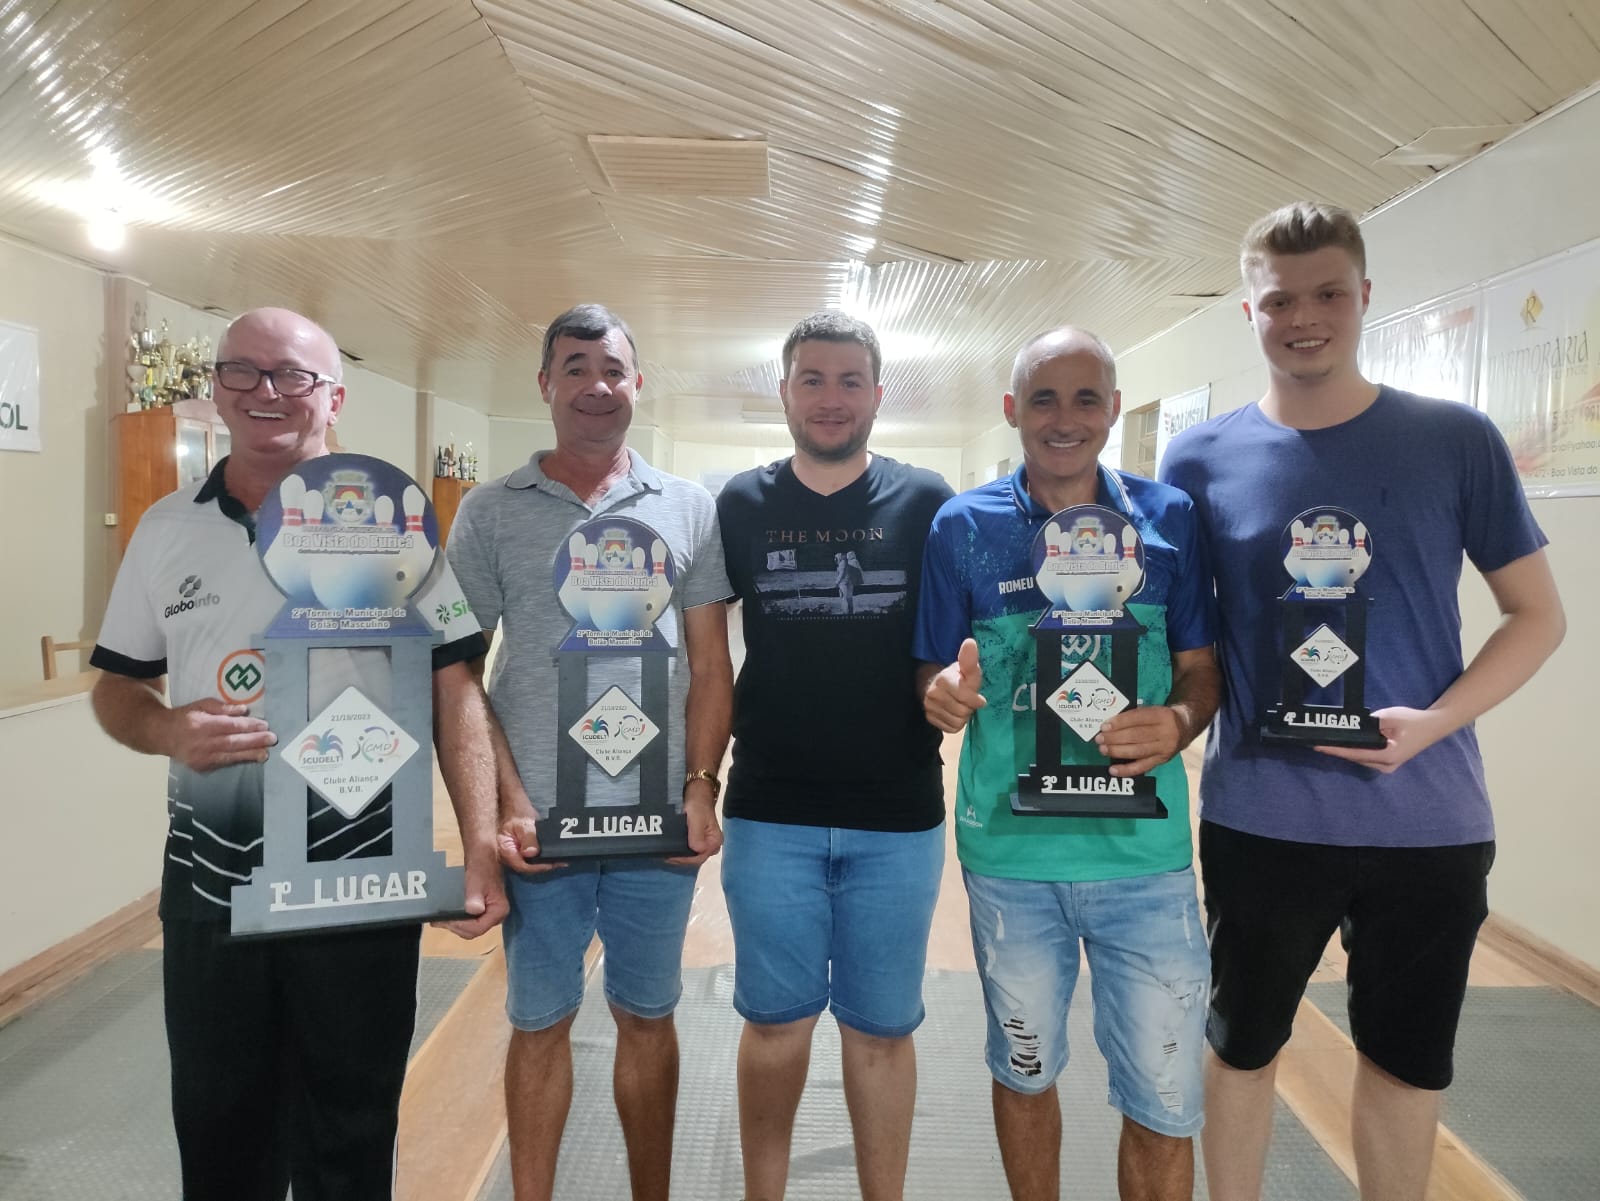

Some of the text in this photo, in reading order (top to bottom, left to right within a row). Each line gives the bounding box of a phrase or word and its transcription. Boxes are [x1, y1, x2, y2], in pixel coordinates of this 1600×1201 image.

[1567, 465, 1585, 476] Vista
[1586, 464, 1598, 475] do
[766, 528, 884, 543] THE MOON
[998, 577, 1034, 595] ROMEU
[305, 608, 342, 618] Torneio
[344, 608, 392, 619] Municipal
[393, 608, 406, 617] de
[309, 619, 390, 629] Bolão Masculino
[1304, 712, 1360, 729] LUGAR
[349, 775, 379, 785] Aliança
[1041, 775, 1135, 795] 3º LUGAR
[560, 815, 663, 838] 2º LUGAR
[314, 870, 427, 905] LUGAR
